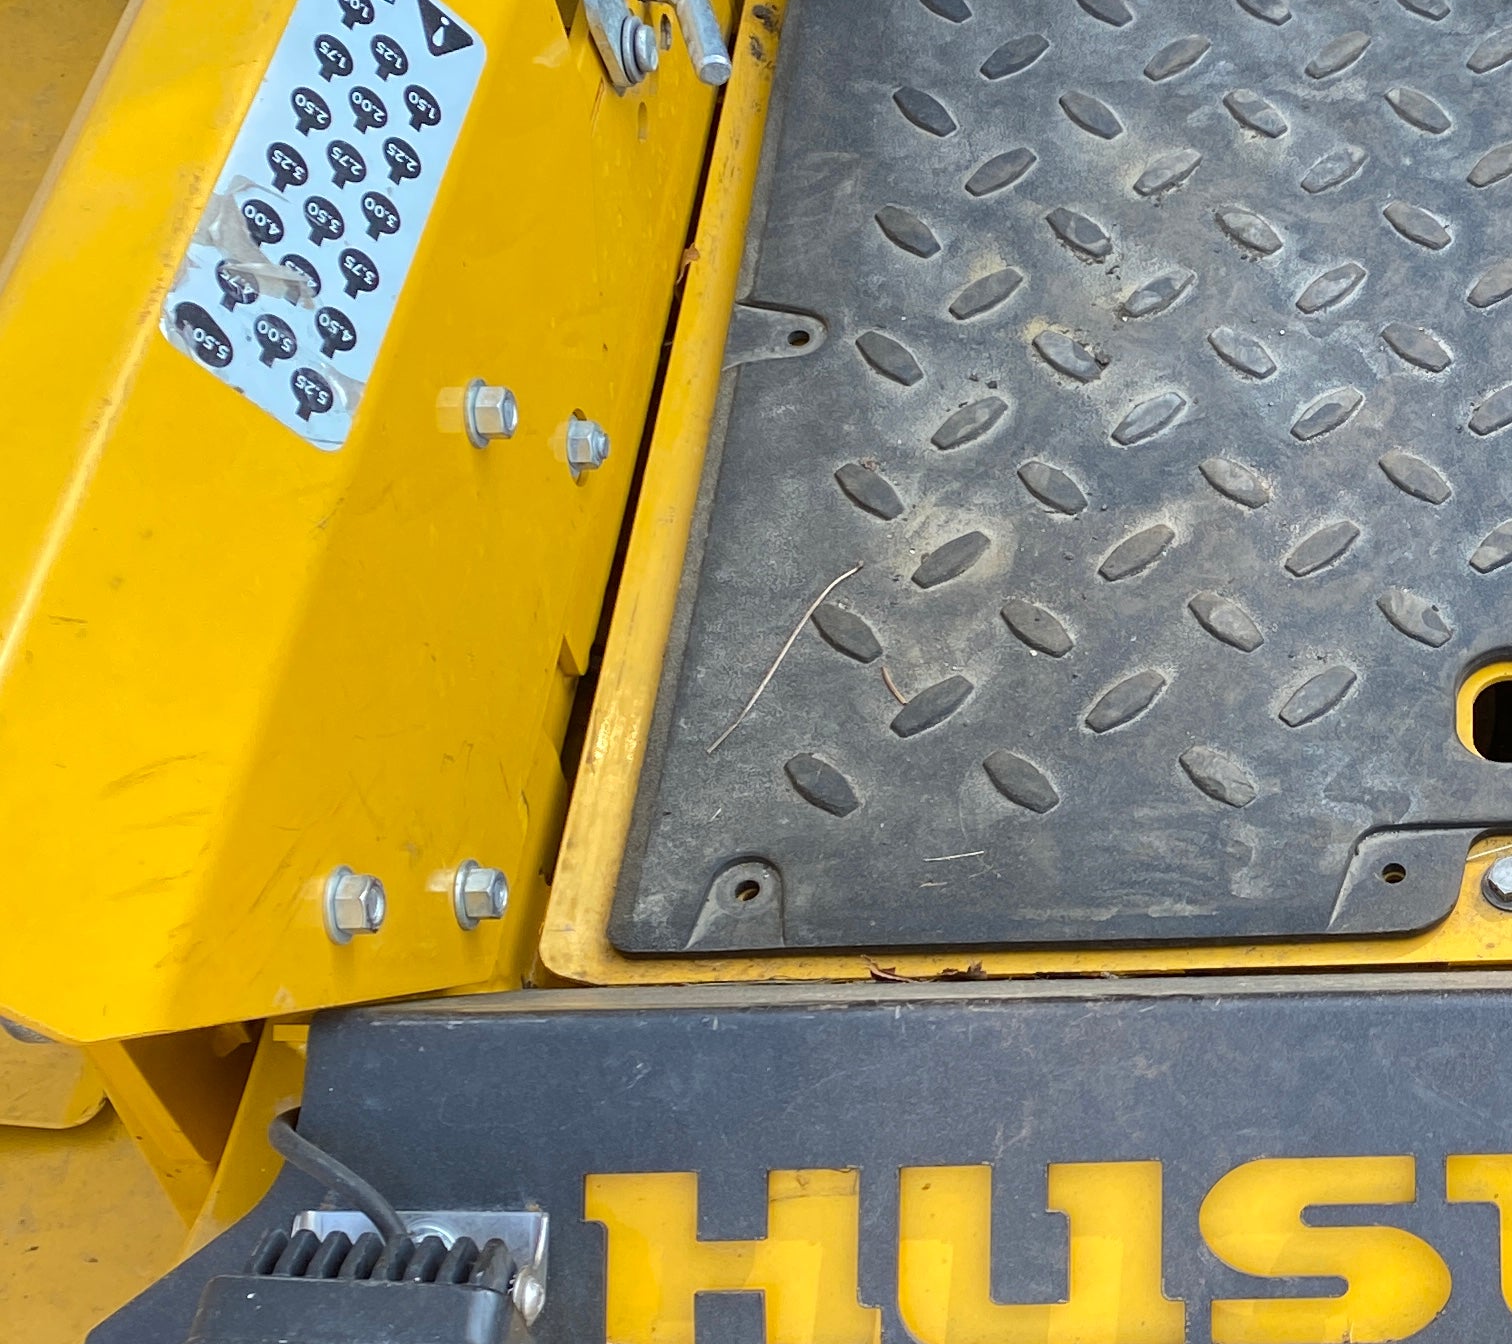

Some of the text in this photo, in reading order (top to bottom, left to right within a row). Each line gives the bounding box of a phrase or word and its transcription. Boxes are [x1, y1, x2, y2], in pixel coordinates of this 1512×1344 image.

[319, 41, 346, 69] 1.75
[375, 41, 402, 69] 1.25
[295, 93, 329, 124] 2.50
[351, 91, 385, 122] 2.00
[408, 91, 435, 119] 1.50
[271, 149, 305, 180] 3.25
[331, 146, 363, 176] 2.75
[387, 143, 418, 172] 2.25
[244, 205, 280, 235] 4.00
[307, 202, 342, 233] 3.50
[364, 197, 397, 228] 3.00
[344, 255, 375, 285] 3.75
[257, 320, 292, 352] 5.00
[318, 313, 353, 342] 4.50
[193, 327, 230, 359] 5.50
[295, 375, 329, 405] 5.25
